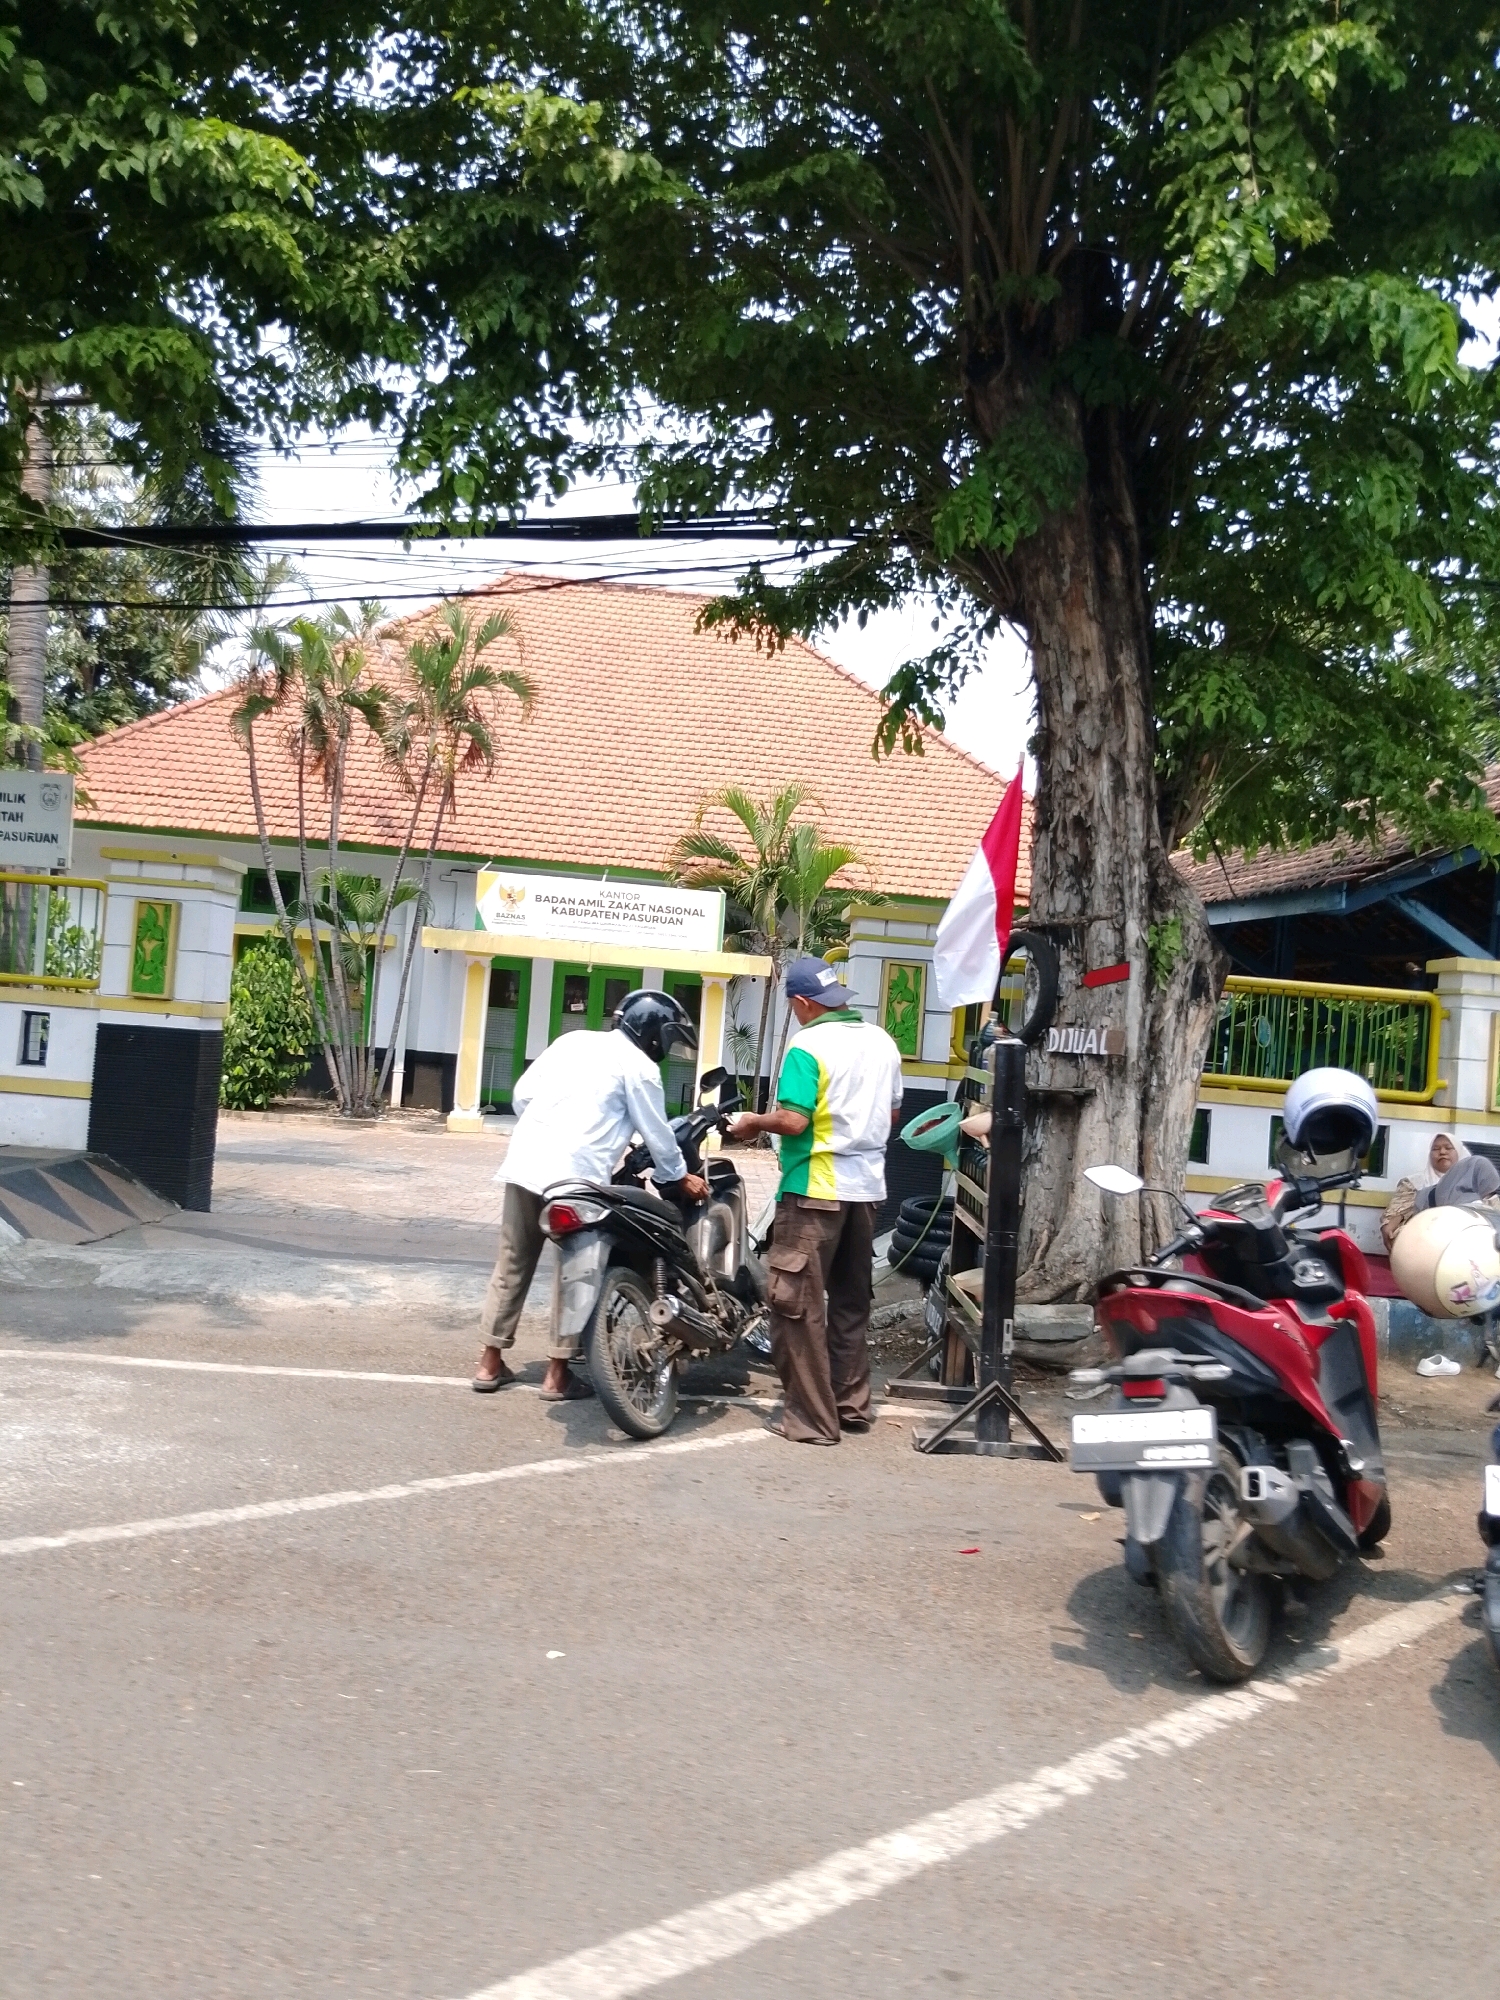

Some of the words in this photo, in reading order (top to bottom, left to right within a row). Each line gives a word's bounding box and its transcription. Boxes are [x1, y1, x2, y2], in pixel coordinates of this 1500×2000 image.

[534, 894, 576, 906] BADAN
[577, 898, 606, 909] AMIL
[608, 900, 647, 912] ZAKAT
[648, 904, 706, 918] NASIONAL
[599, 890, 641, 901] KANTOR
[495, 912, 526, 921] BAZNAS
[551, 905, 620, 921] KABUPATEN
[622, 912, 684, 926] PASURUAN
[1046, 1026, 1109, 1055] DIJUAL
